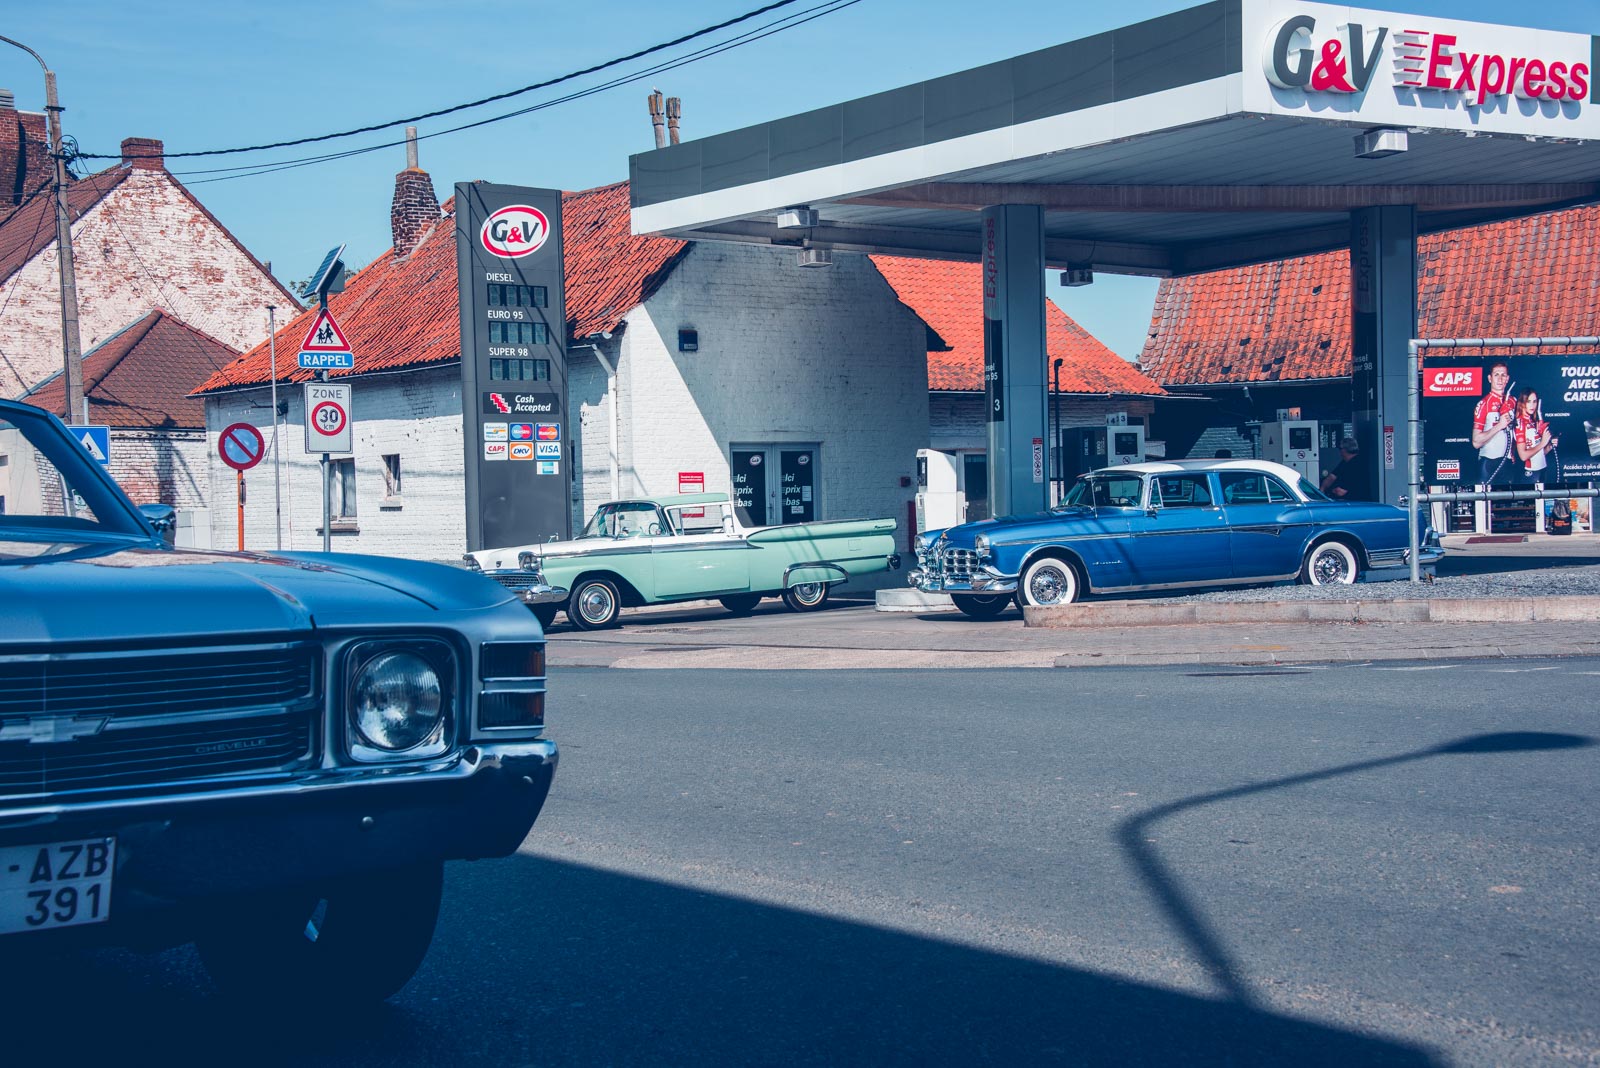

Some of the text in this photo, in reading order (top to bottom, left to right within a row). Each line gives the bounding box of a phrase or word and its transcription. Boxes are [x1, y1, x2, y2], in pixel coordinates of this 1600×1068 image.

[1267, 15, 1589, 105] G&V Express
[491, 219, 540, 243] G&V
[986, 217, 997, 298] Express
[1357, 215, 1372, 292] Express
[486, 273, 514, 282] DIESEL
[488, 310, 523, 320] EURO 95
[489, 347, 529, 357] SUPER 98
[304, 354, 348, 366] RAPPEL
[1561, 366, 1600, 377] TOUJO
[1434, 372, 1472, 385] CAPS
[1568, 379, 1599, 389] AVEC
[312, 389, 342, 399] ZONE
[1368, 387, 1374, 400] 1
[515, 395, 534, 403] Cash
[515, 403, 551, 413] Accepted
[994, 398, 1000, 411] 3
[319, 408, 339, 423] 30
[539, 445, 559, 453] VISA
[736, 474, 747, 482] Ici
[785, 473, 795, 482] Ici
[737, 486, 753, 496] prix
[785, 485, 801, 495] prix
[737, 498, 753, 507] bas
[785, 498, 800, 506] bas
[195, 738, 266, 754] CHEVELLE
[25, 883, 102, 927] 391
